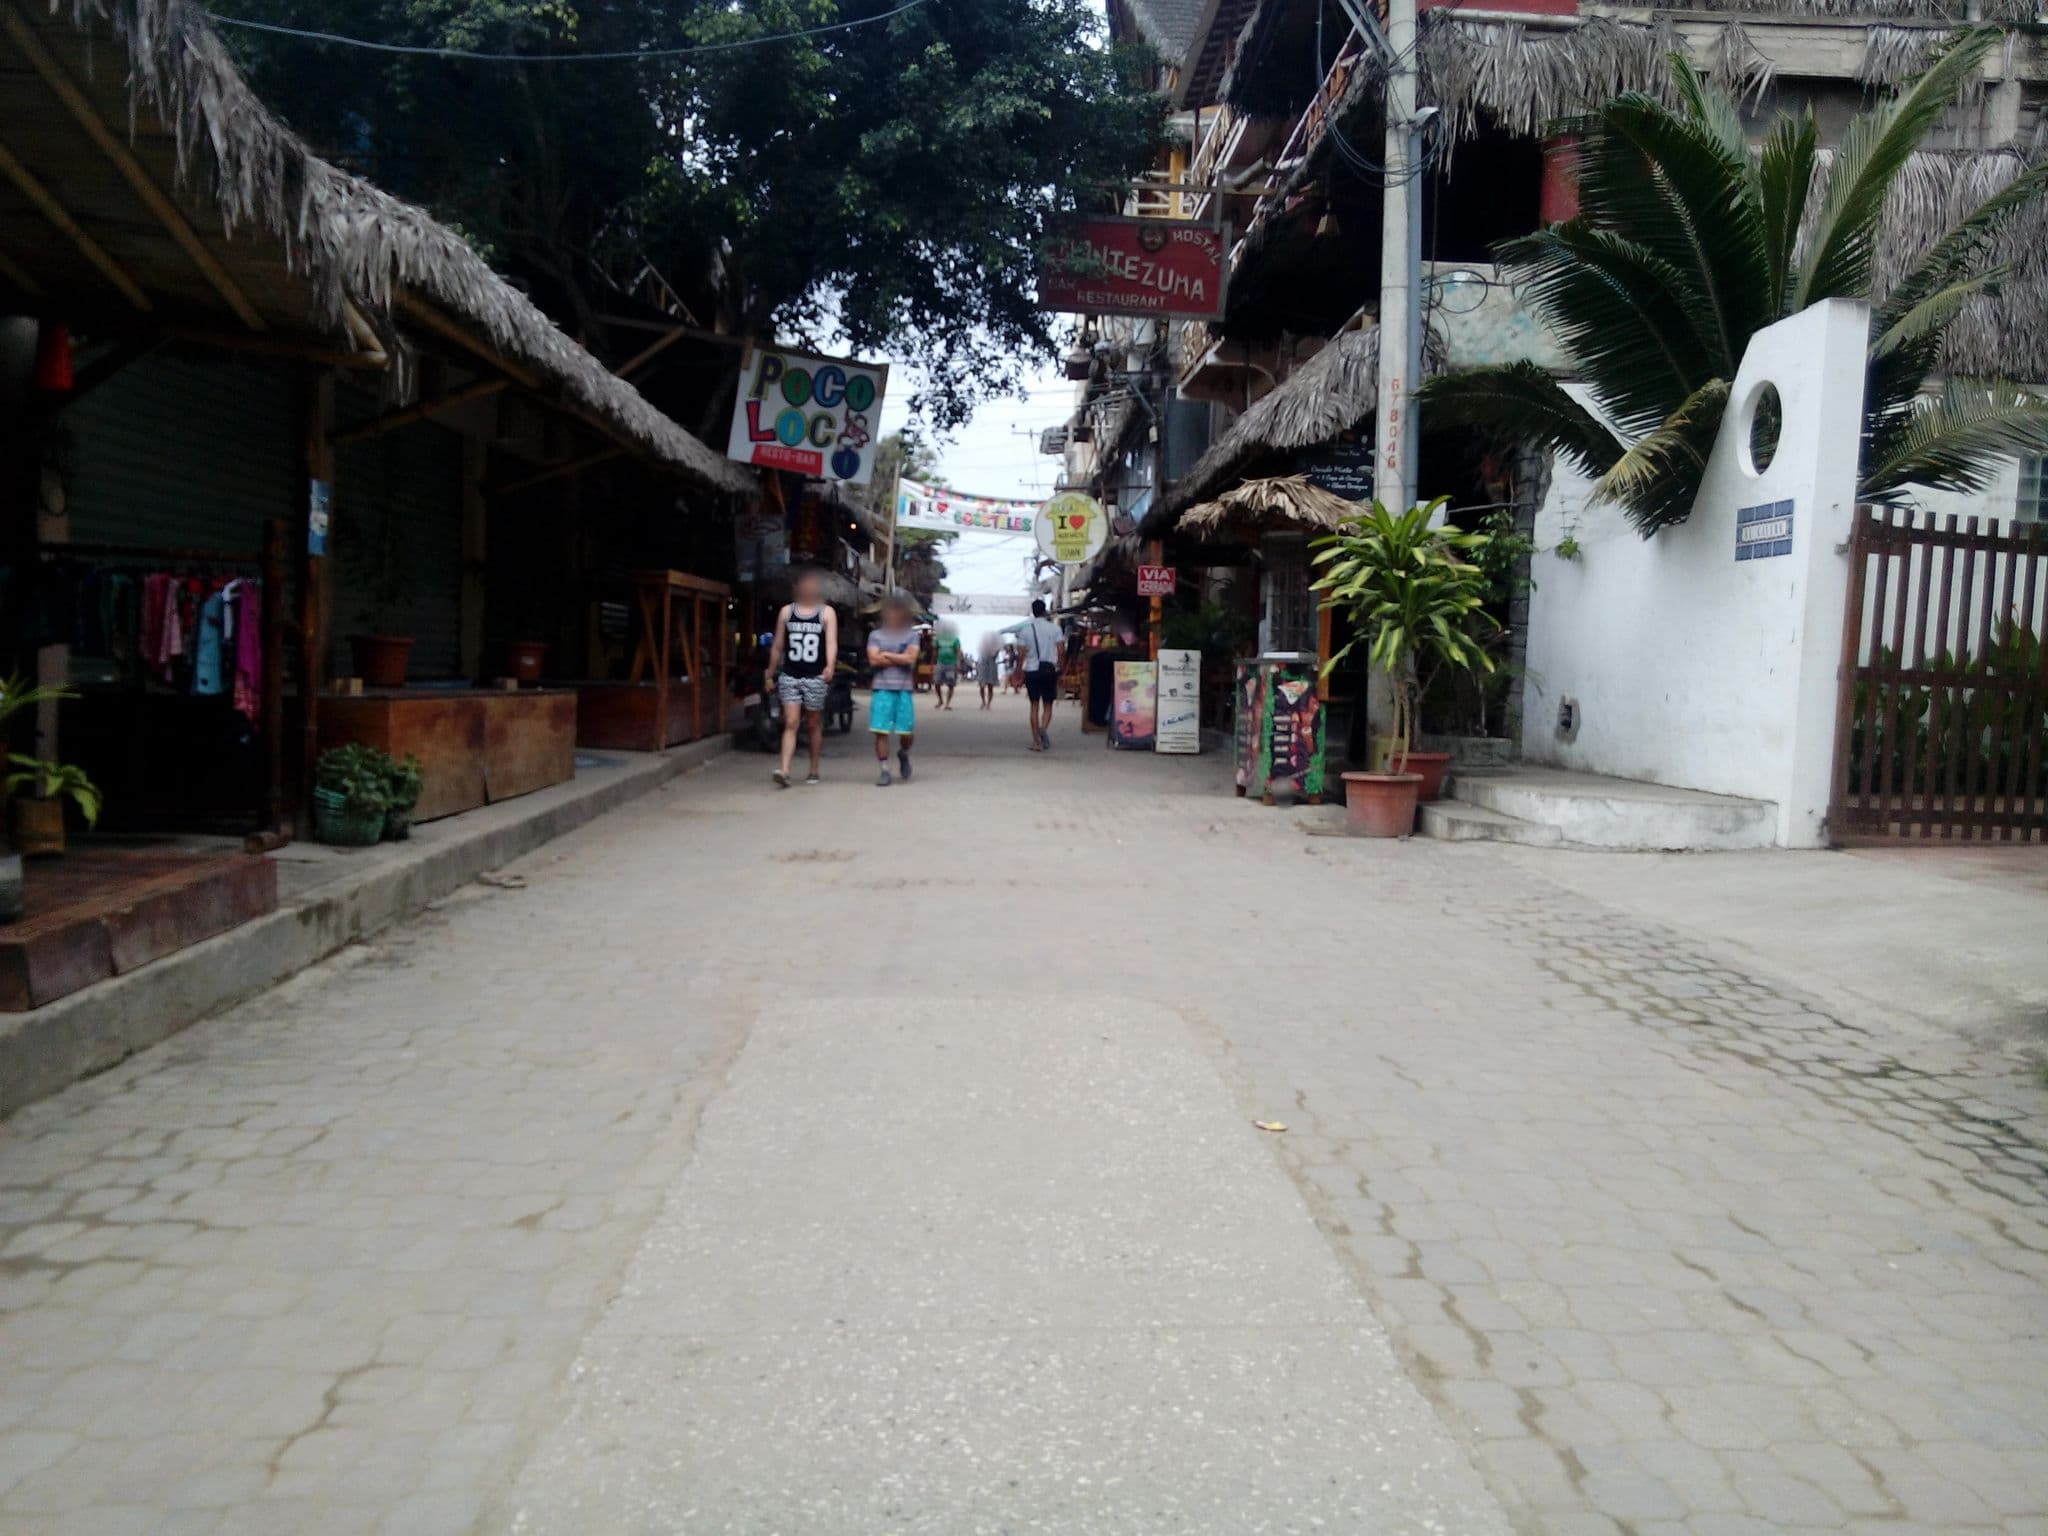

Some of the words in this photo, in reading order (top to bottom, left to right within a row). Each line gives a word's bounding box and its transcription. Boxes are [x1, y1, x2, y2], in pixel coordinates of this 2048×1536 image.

[1172, 229, 1221, 265] HOSTAL
[1076, 290, 1167, 307] RESTAURANT
[750, 351, 876, 412] POCO
[1058, 515, 1067, 529] I
[1143, 569, 1170, 580] VIA
[788, 633, 819, 662] 58
